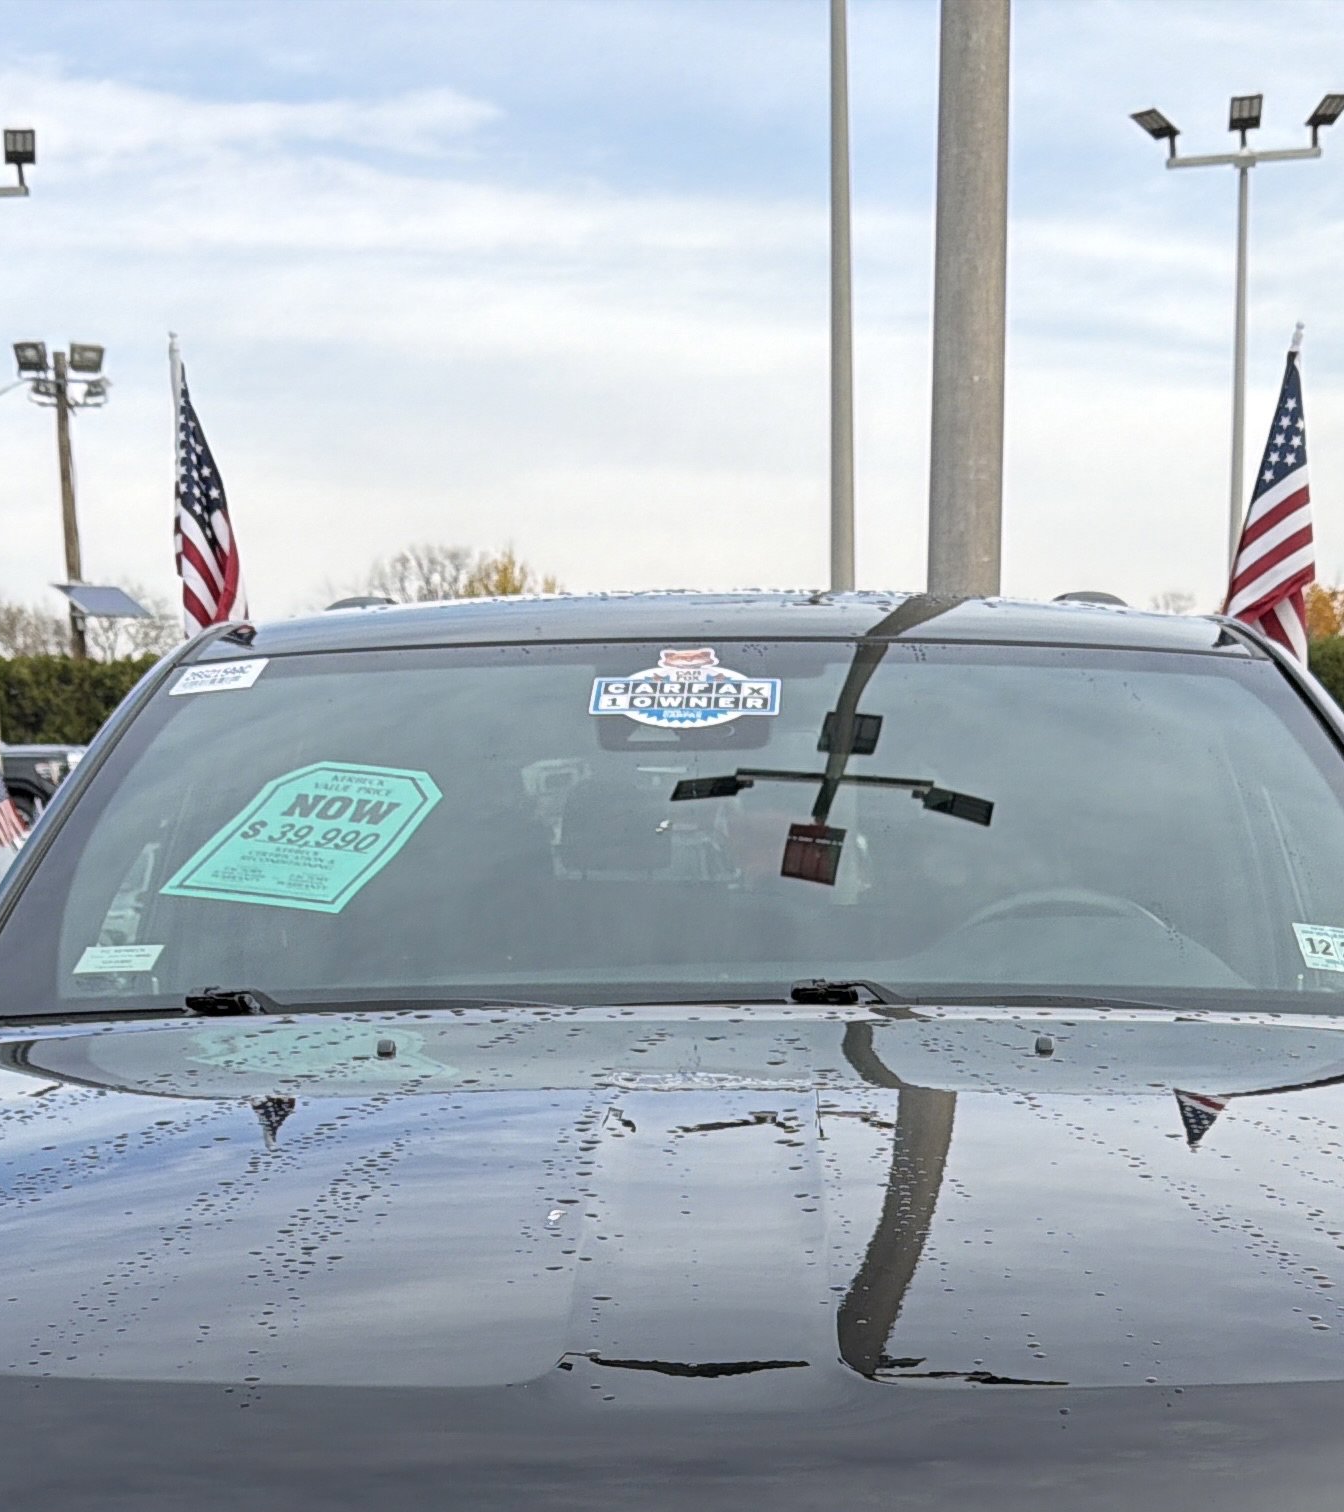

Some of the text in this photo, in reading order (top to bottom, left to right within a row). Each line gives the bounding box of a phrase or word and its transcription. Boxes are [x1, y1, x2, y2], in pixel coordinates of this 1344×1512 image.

[607, 683, 765, 697] CARFAX
[633, 696, 764, 709] OWNER
[280, 793, 402, 826] NOW
[268, 823, 381, 852] 39,990
[1305, 937, 1334, 957] 12
